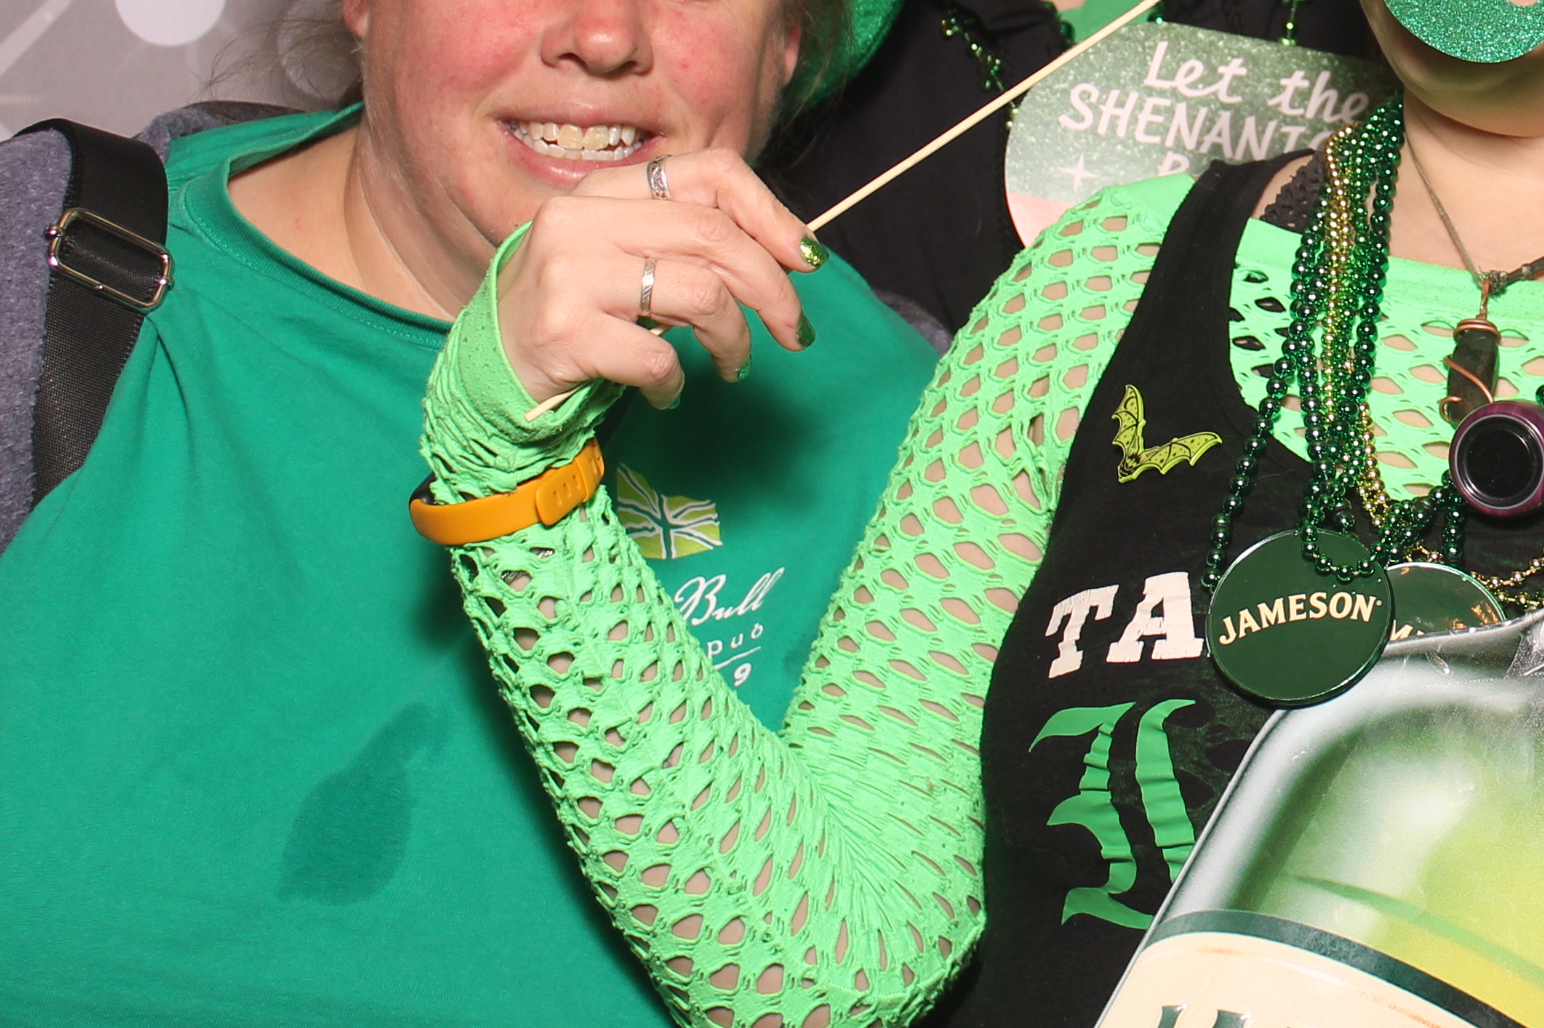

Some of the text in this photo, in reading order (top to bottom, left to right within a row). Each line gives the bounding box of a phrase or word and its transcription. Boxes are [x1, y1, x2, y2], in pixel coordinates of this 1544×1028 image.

[1142, 40, 1369, 124] Let the
[1044, 570, 1206, 679] TA
[1218, 590, 1378, 646] JAMESON
